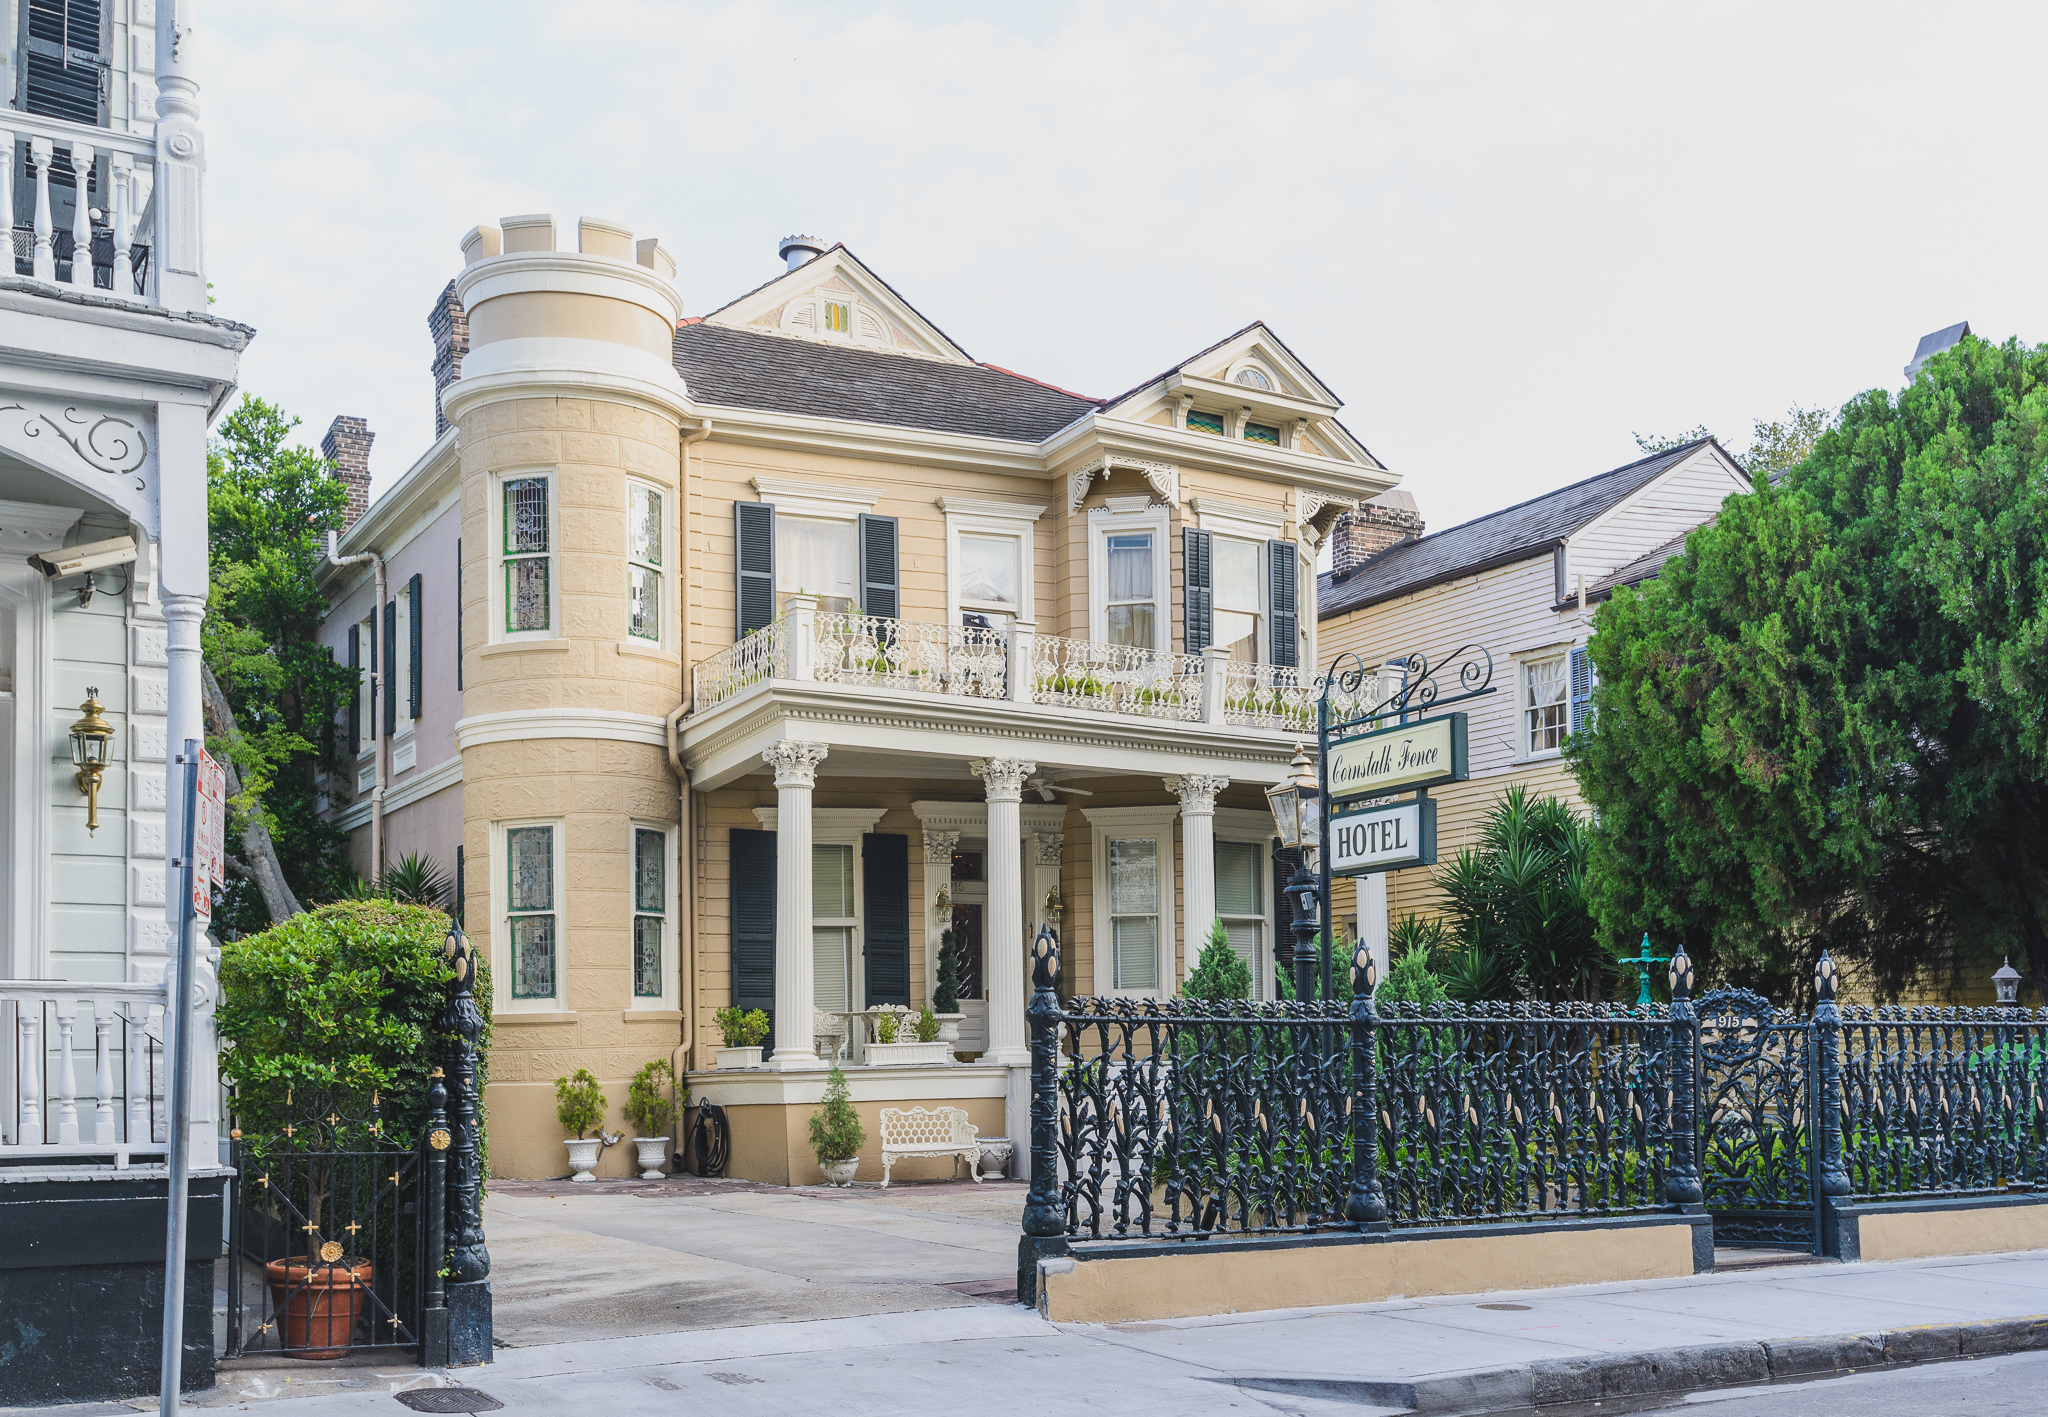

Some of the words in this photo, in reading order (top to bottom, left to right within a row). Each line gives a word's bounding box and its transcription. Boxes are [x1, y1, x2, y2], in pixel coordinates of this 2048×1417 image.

[1332, 744, 1392, 784] Cornstalk
[1397, 739, 1438, 771] Fence
[1337, 817, 1408, 859] HOTEL
[1718, 1015, 1740, 1028] 915
